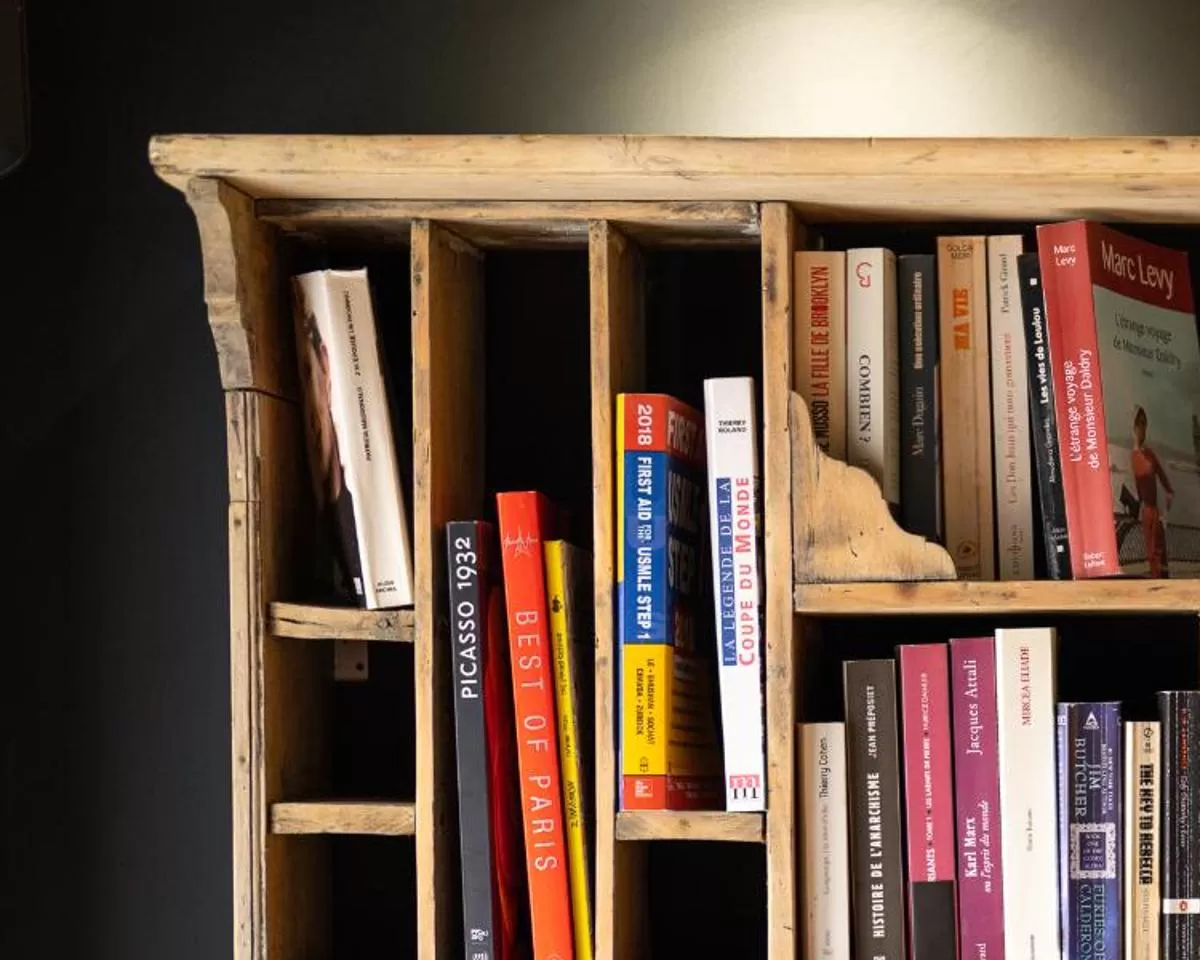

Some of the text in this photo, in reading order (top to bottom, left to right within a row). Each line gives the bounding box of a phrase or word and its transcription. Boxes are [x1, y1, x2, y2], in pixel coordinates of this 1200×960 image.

[1099, 241, 1174, 300] Marc Levy
[811, 264, 829, 396] LA FILLE DE BROOKLYN
[1030, 305, 1051, 404] Les vies de Loulou
[636, 404, 653, 447] 2018
[857, 354, 872, 434] COMBIEN
[1062, 359, 1084, 461] L'étrange voyage
[1079, 347, 1101, 468] de Monsieur Daldry
[636, 456, 652, 521] FIRST AID
[716, 480, 732, 503] LA
[718, 513, 734, 536] DE
[636, 546, 653, 641] USMLE STEP 1
[734, 475, 756, 666] COUPE DU MONDE
[454, 535, 479, 699] PICASSO 1932
[722, 639, 738, 664] LA
[1018, 644, 1033, 725] MIRCEA ELIADE
[514, 610, 557, 874] BEST OF PARIS
[816, 736, 830, 765] Cohen
[961, 658, 985, 877] Karl Marx Jacques Attali
[1073, 737, 1088, 817] BUTCHER
[1087, 762, 1102, 790] JIM
[1138, 763, 1154, 786] THE
[816, 766, 832, 798] Thierry
[866, 771, 886, 937] HISTOIRE DE L'ANARCHISME
[977, 798, 991, 846] du monde
[1138, 815, 1154, 830] TO
[1092, 940, 1106, 960] OF
